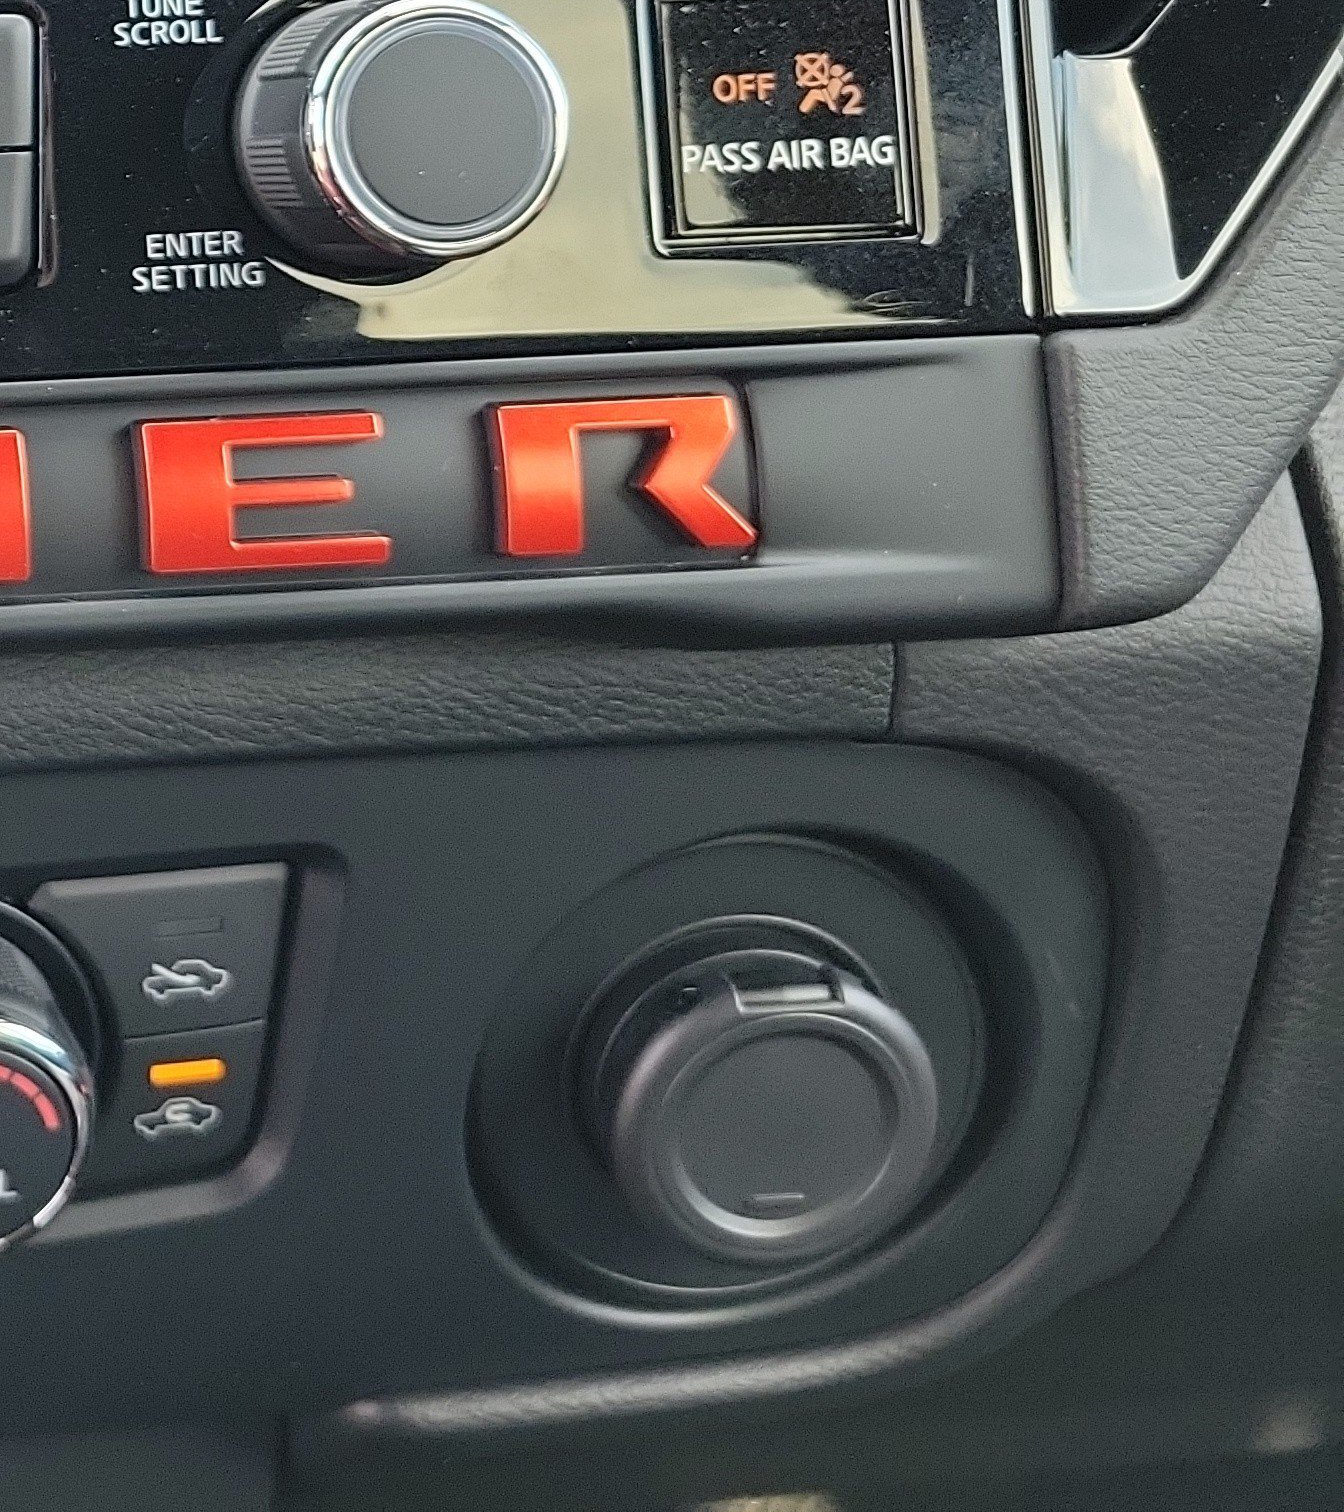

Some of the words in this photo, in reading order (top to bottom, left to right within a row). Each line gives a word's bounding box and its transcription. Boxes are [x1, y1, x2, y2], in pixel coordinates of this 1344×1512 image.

[113, 17, 223, 47] SCROLL
[712, 72, 776, 104] OFF
[680, 143, 762, 175] PASS
[767, 138, 826, 170] AIR
[829, 134, 896, 168] BAG
[145, 230, 244, 260] ENTER
[131, 259, 266, 292] SETTING
